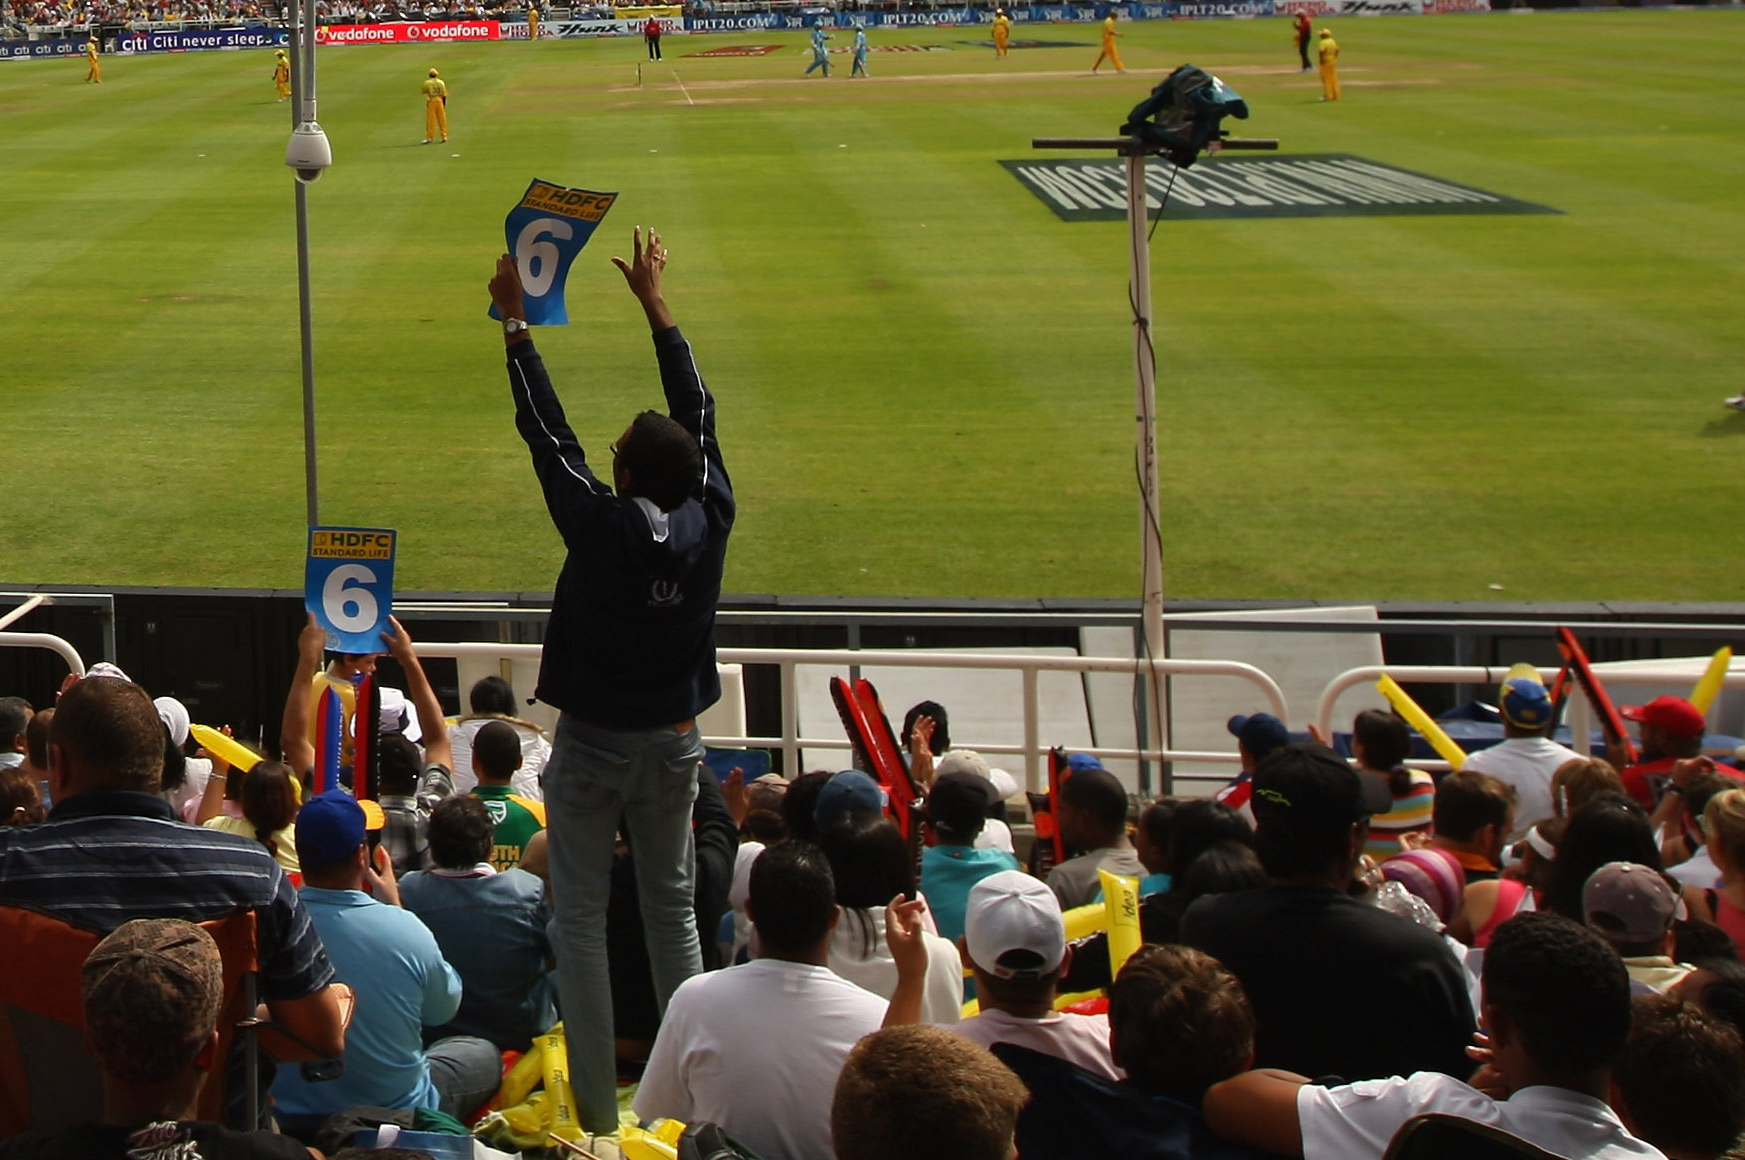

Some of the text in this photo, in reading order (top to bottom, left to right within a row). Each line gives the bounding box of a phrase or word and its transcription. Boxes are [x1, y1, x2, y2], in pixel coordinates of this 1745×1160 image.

[692, 17, 770, 29] IPLT20.COM
[883, 13, 962, 25] IPLT20.COM
[329, 26, 394, 41] vodafone
[421, 24, 489, 38] vodafone
[557, 23, 624, 35] Hunk
[122, 36, 148, 51] citi
[154, 34, 178, 48] Citi
[182, 35, 222, 48] never
[524, 198, 579, 216] STANDARD
[548, 190, 610, 210] HDFC
[515, 218, 573, 297] 6
[330, 533, 389, 548] HDFC
[312, 548, 389, 558] STANDARD LIFE
[322, 563, 379, 634] 6
[1121, 889, 1136, 920] Idea
